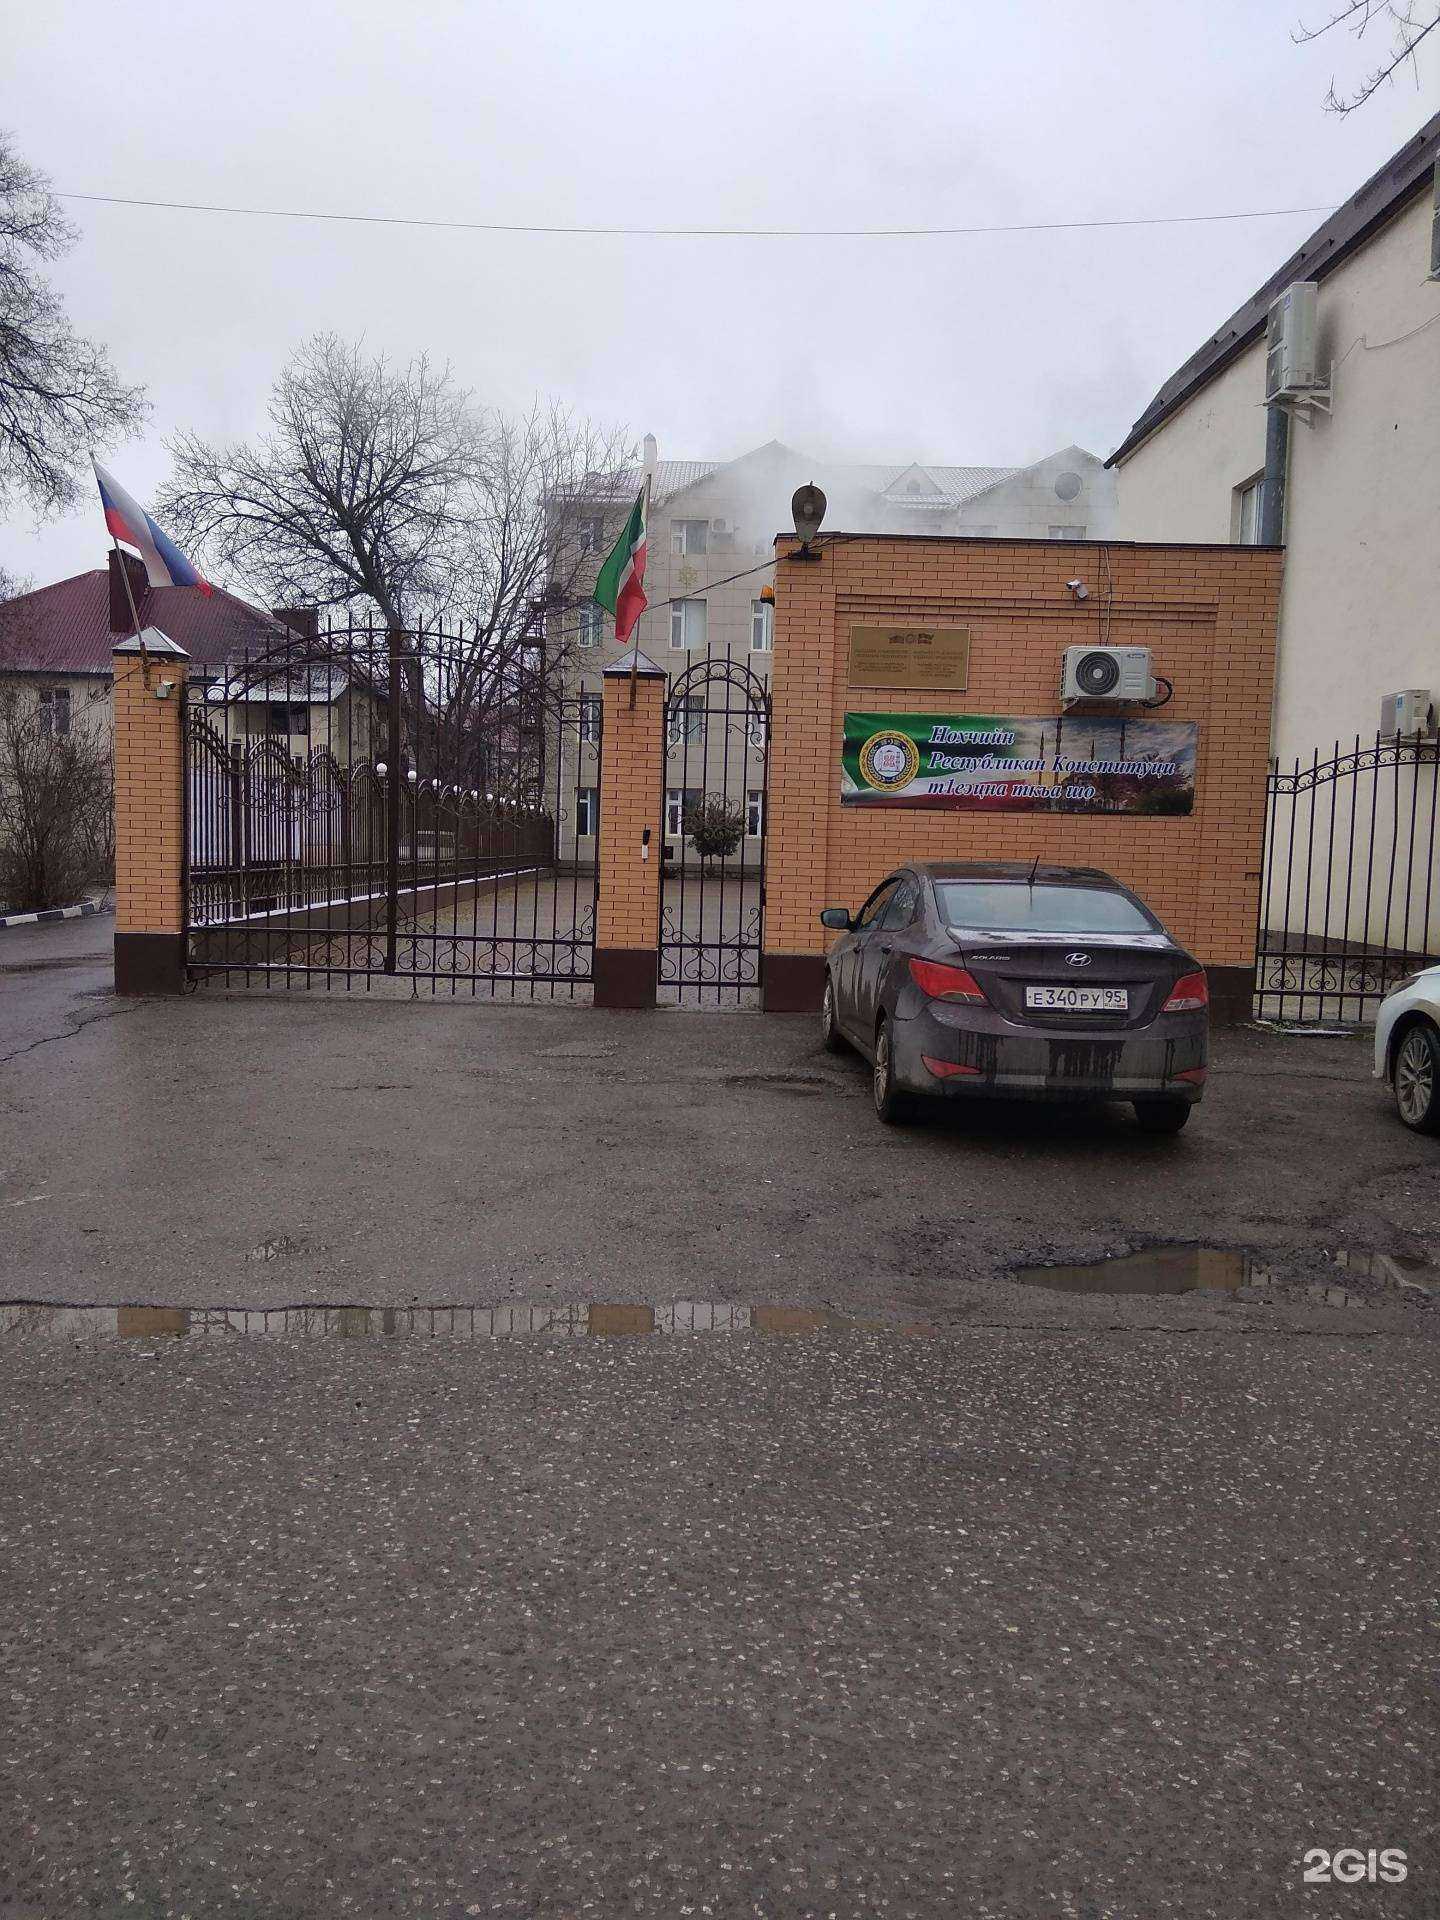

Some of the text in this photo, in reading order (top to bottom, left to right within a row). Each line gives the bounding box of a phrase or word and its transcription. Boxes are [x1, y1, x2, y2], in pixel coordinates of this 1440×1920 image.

[929, 726, 1015, 745] Нохчийн
[928, 752, 1176, 779] Республикан Конституци
[1011, 784, 1062, 798] ткъа
[1066, 785, 1096, 799] шо
[1105, 990, 1122, 1003] 95
